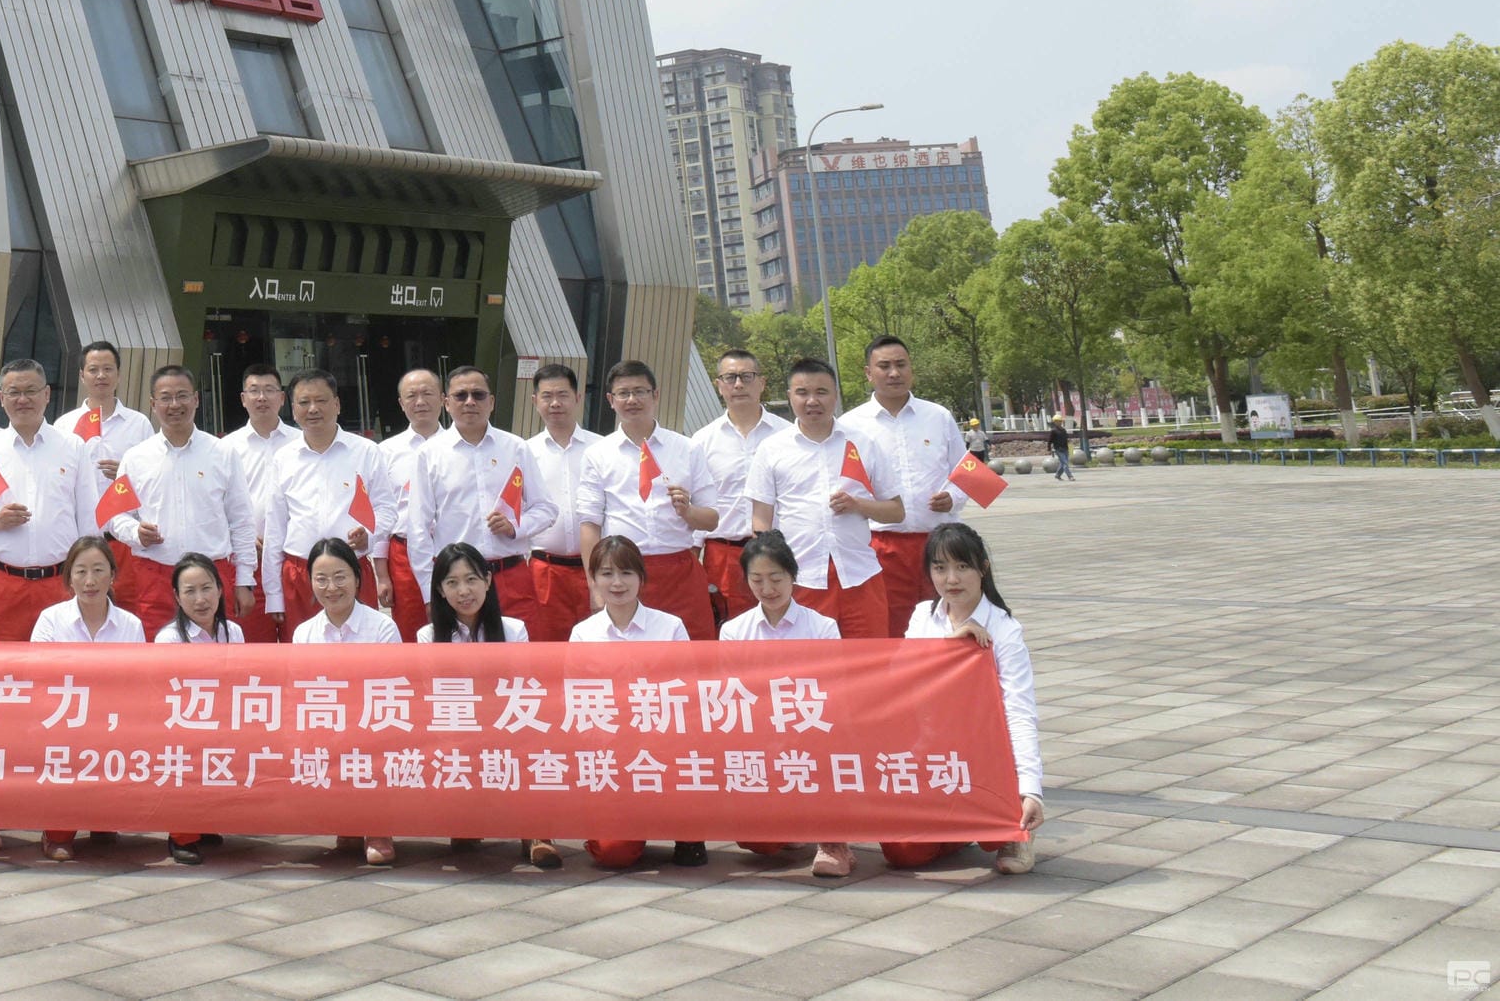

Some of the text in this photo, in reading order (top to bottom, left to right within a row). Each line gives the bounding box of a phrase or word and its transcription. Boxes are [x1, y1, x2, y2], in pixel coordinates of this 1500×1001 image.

[851, 151, 950, 170] 维也纳酒店
[249, 277, 279, 300] 入口
[277, 293, 296, 302] ENTER
[391, 284, 417, 306] 出口
